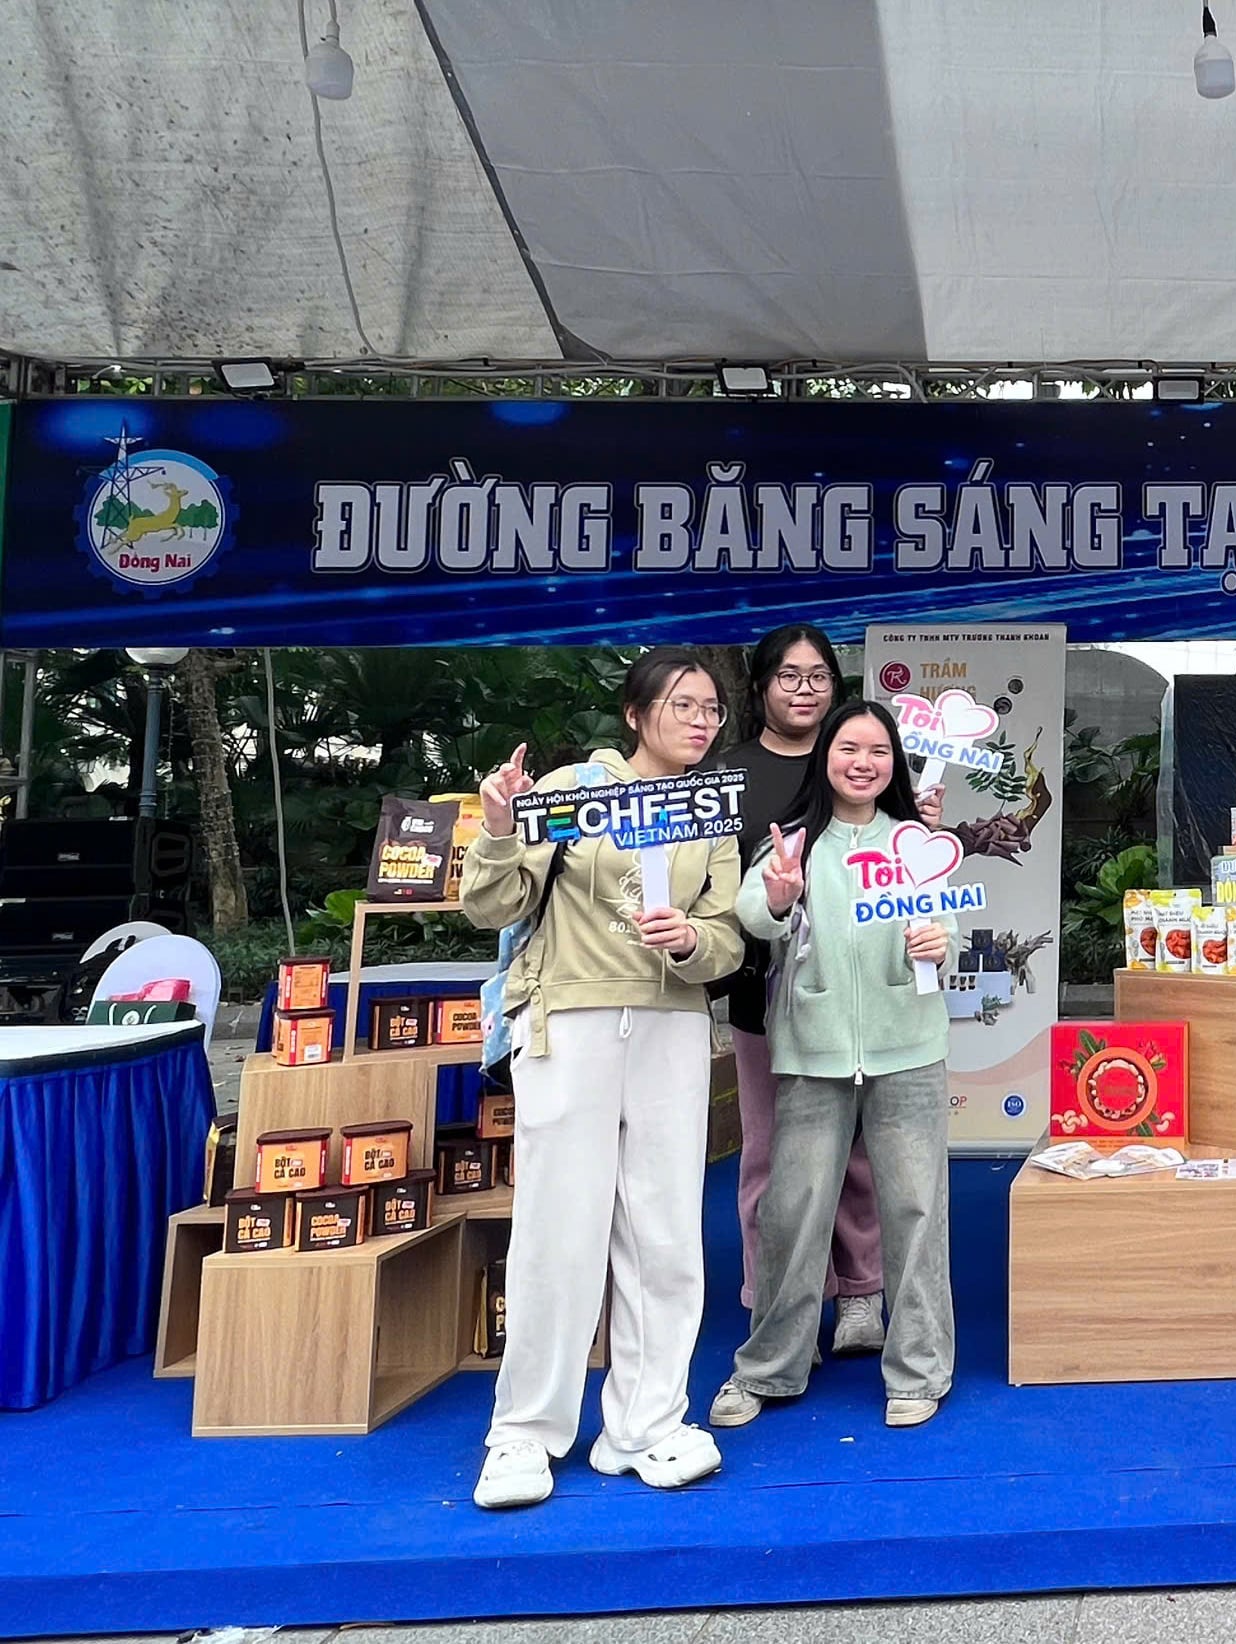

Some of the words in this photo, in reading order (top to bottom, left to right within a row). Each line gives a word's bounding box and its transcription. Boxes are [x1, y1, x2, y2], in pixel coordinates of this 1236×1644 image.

[313, 458, 610, 573] ĐƯỜNG
[634, 461, 871, 573] BĂNG
[895, 458, 1123, 573] SÁNG
[164, 553, 191, 568] Nai
[883, 633, 905, 642] CÔNG
[907, 634, 917, 642] TY
[903, 731, 954, 759] ỒNG
[959, 748, 1001, 769] NAI
[516, 793, 544, 808] NGÀY
[547, 793, 564, 806] HỘI
[590, 786, 626, 800] NGHIỆP
[628, 781, 654, 795] SÁNG
[655, 781, 675, 793] TẠO
[676, 775, 703, 789] QUỐC
[704, 776, 720, 785] GIA
[721, 773, 744, 783] 2025
[517, 784, 746, 843] TECHFEST
[616, 822, 698, 847] VIETNAM
[703, 818, 743, 836] 2025
[381, 845, 426, 862] COCOA
[378, 861, 436, 879] POWDER
[847, 850, 905, 889] Tôi
[855, 891, 934, 923] ĐỒNG
[940, 887, 983, 911] NAI
[364, 1147, 380, 1160] BỘT
[274, 1156, 291, 1169] BỘT
[364, 1159, 376, 1170] CA
[378, 1158, 395, 1169] CAO
[274, 1168, 286, 1179] CA
[288, 1167, 306, 1178] CAO
[311, 1213, 340, 1227] COCOA
[398, 1209, 416, 1220] CAO
[252, 1226, 271, 1238] CAO
